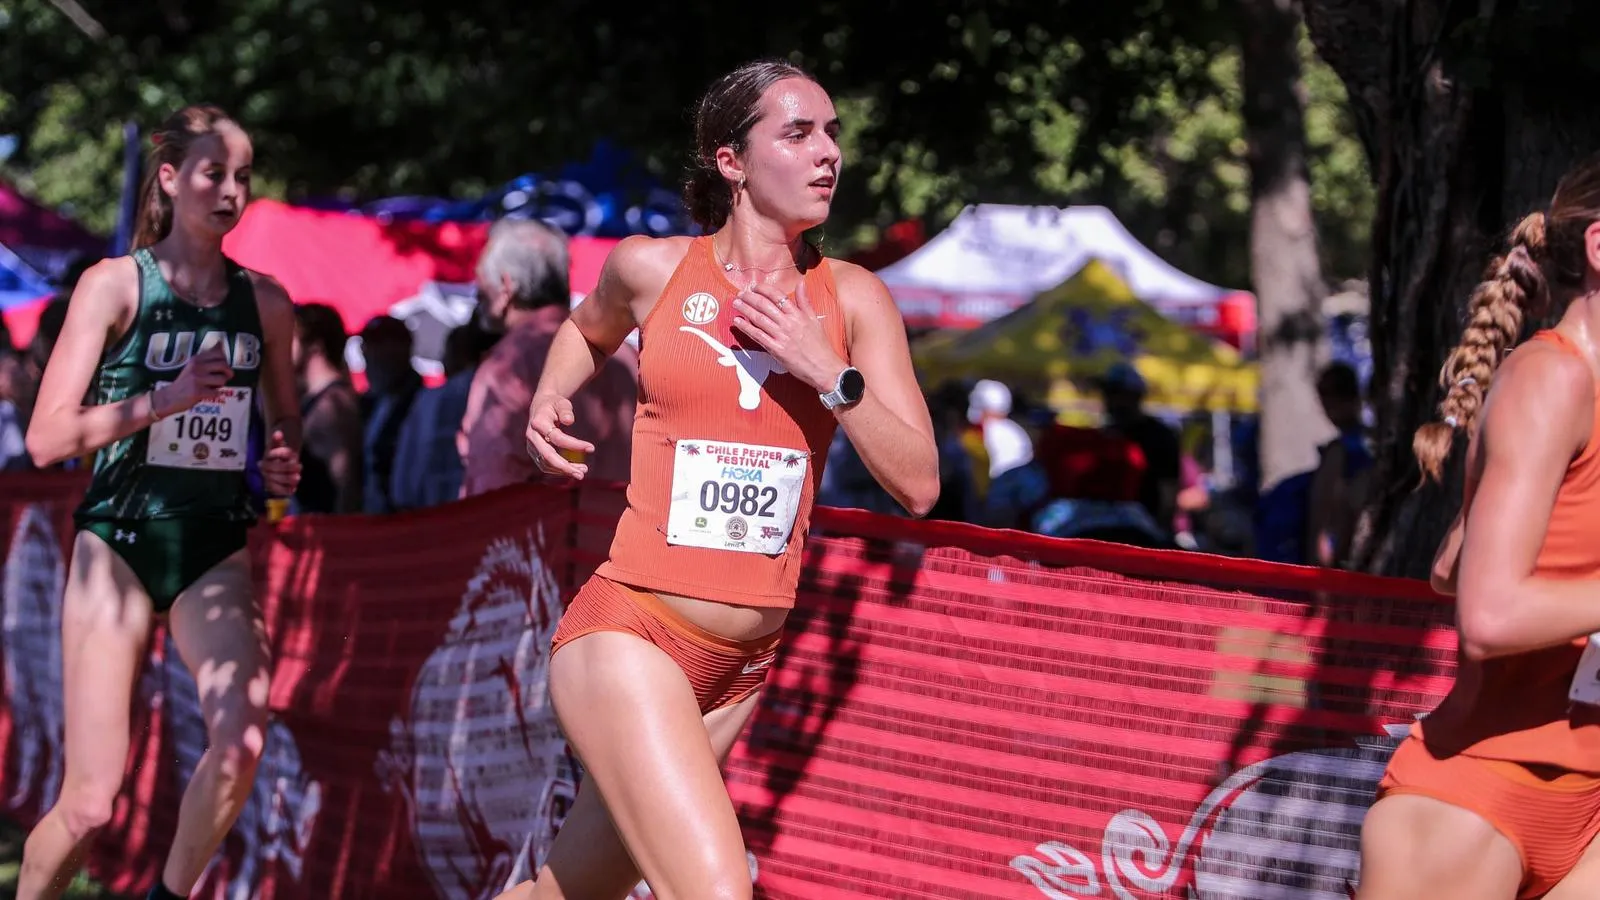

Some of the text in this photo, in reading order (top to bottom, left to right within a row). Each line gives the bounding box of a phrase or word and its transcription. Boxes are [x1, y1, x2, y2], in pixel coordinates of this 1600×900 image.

[684, 294, 717, 323] SEC
[145, 331, 261, 371] UAB
[174, 415, 232, 442] 1049
[706, 445, 782, 461] CHILE PEPPER
[716, 455, 770, 469] FESTIVAL
[721, 467, 762, 482] HOKA
[700, 480, 778, 518] 0982
